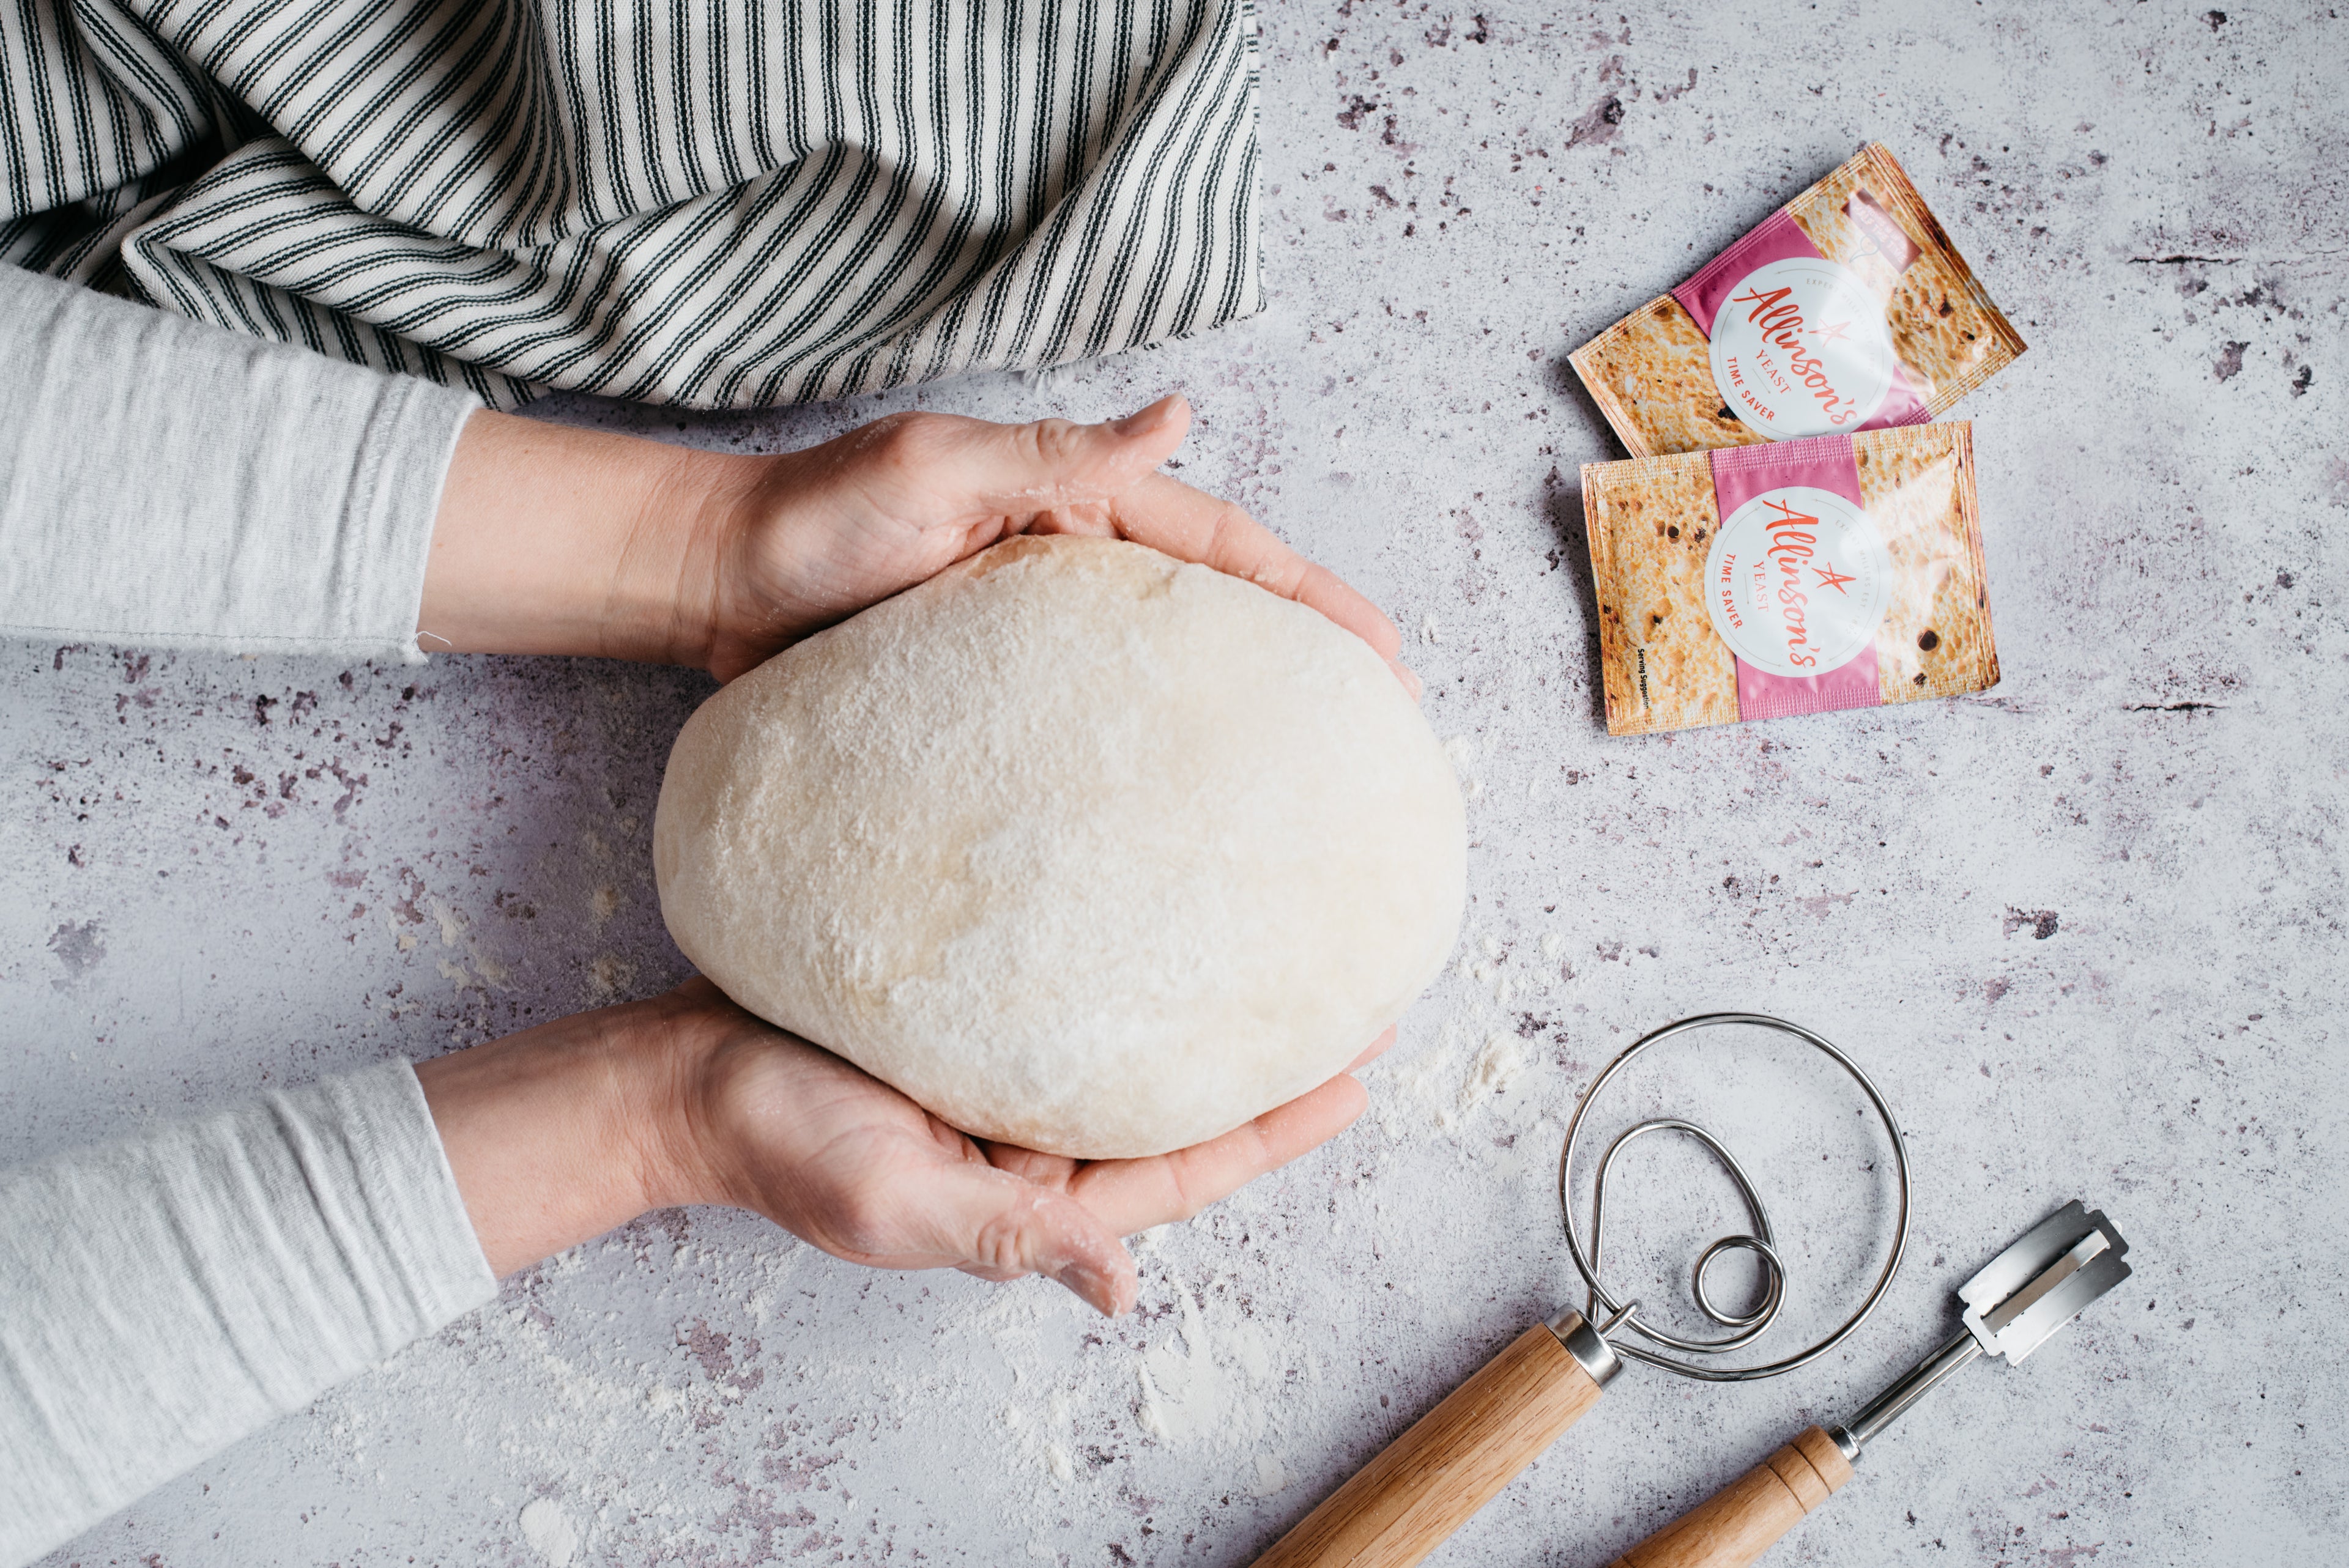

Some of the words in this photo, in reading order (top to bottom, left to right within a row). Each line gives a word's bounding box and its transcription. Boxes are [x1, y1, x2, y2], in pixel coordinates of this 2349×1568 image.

[1732, 286, 1857, 425] Allinson's
[1756, 349, 1792, 394] YEAST
[1727, 357, 1745, 387] TIME
[1741, 390, 1775, 421] SAVER
[1721, 553, 1736, 583] TIME
[1753, 561, 1769, 612] YEAST
[1762, 498, 1821, 668] Allinson's
[1721, 590, 1743, 629] SAVER
[1638, 648, 1646, 674] Serving
[1640, 675, 1650, 709] Suggestion
